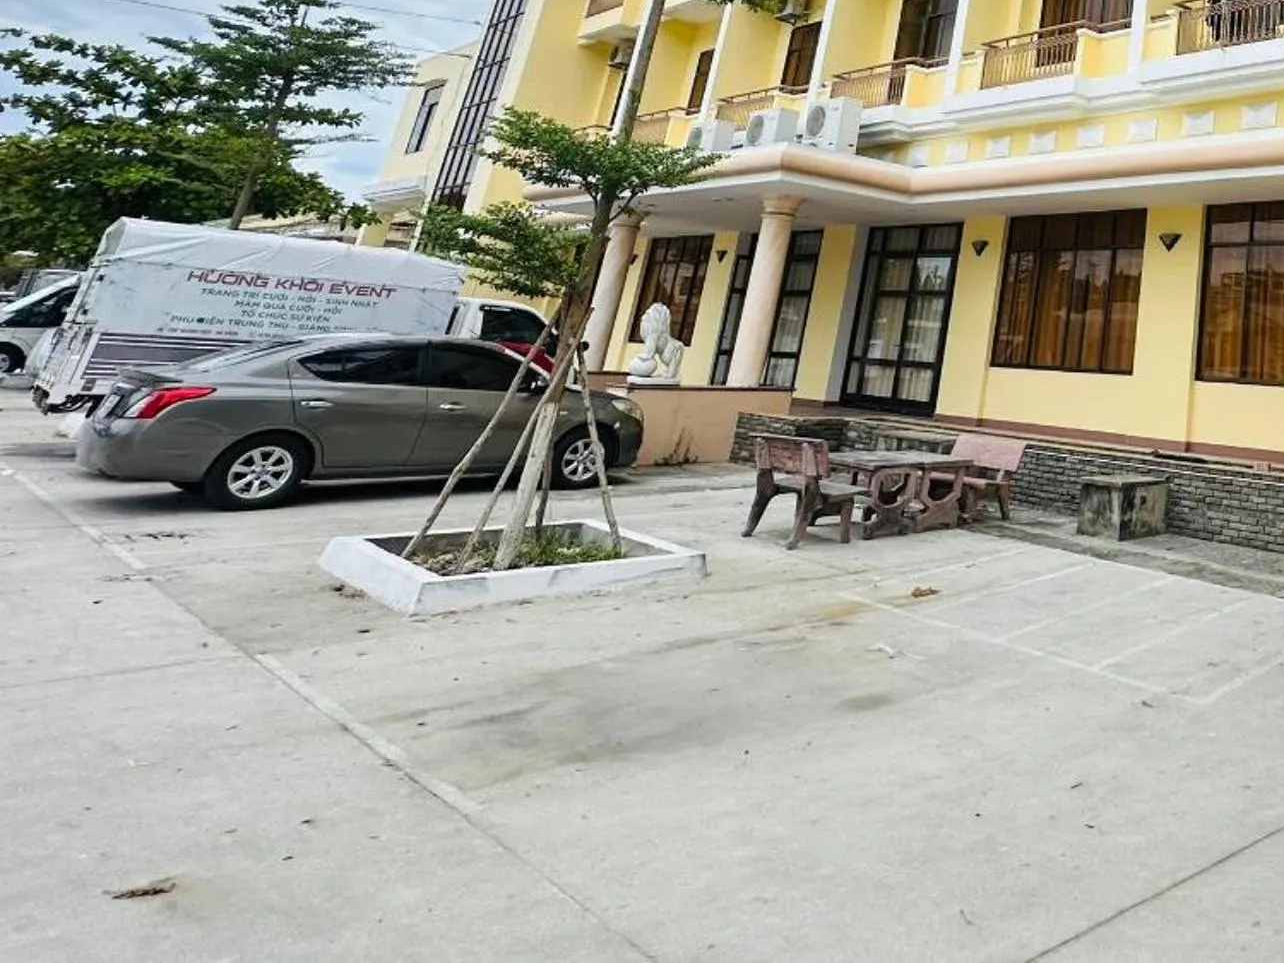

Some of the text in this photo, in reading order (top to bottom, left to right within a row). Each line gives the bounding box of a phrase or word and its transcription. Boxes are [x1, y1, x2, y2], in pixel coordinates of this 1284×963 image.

[201, 287, 240, 298] TRANG
[328, 281, 397, 298] EVENT
[228, 318, 265, 329] TRUNG
